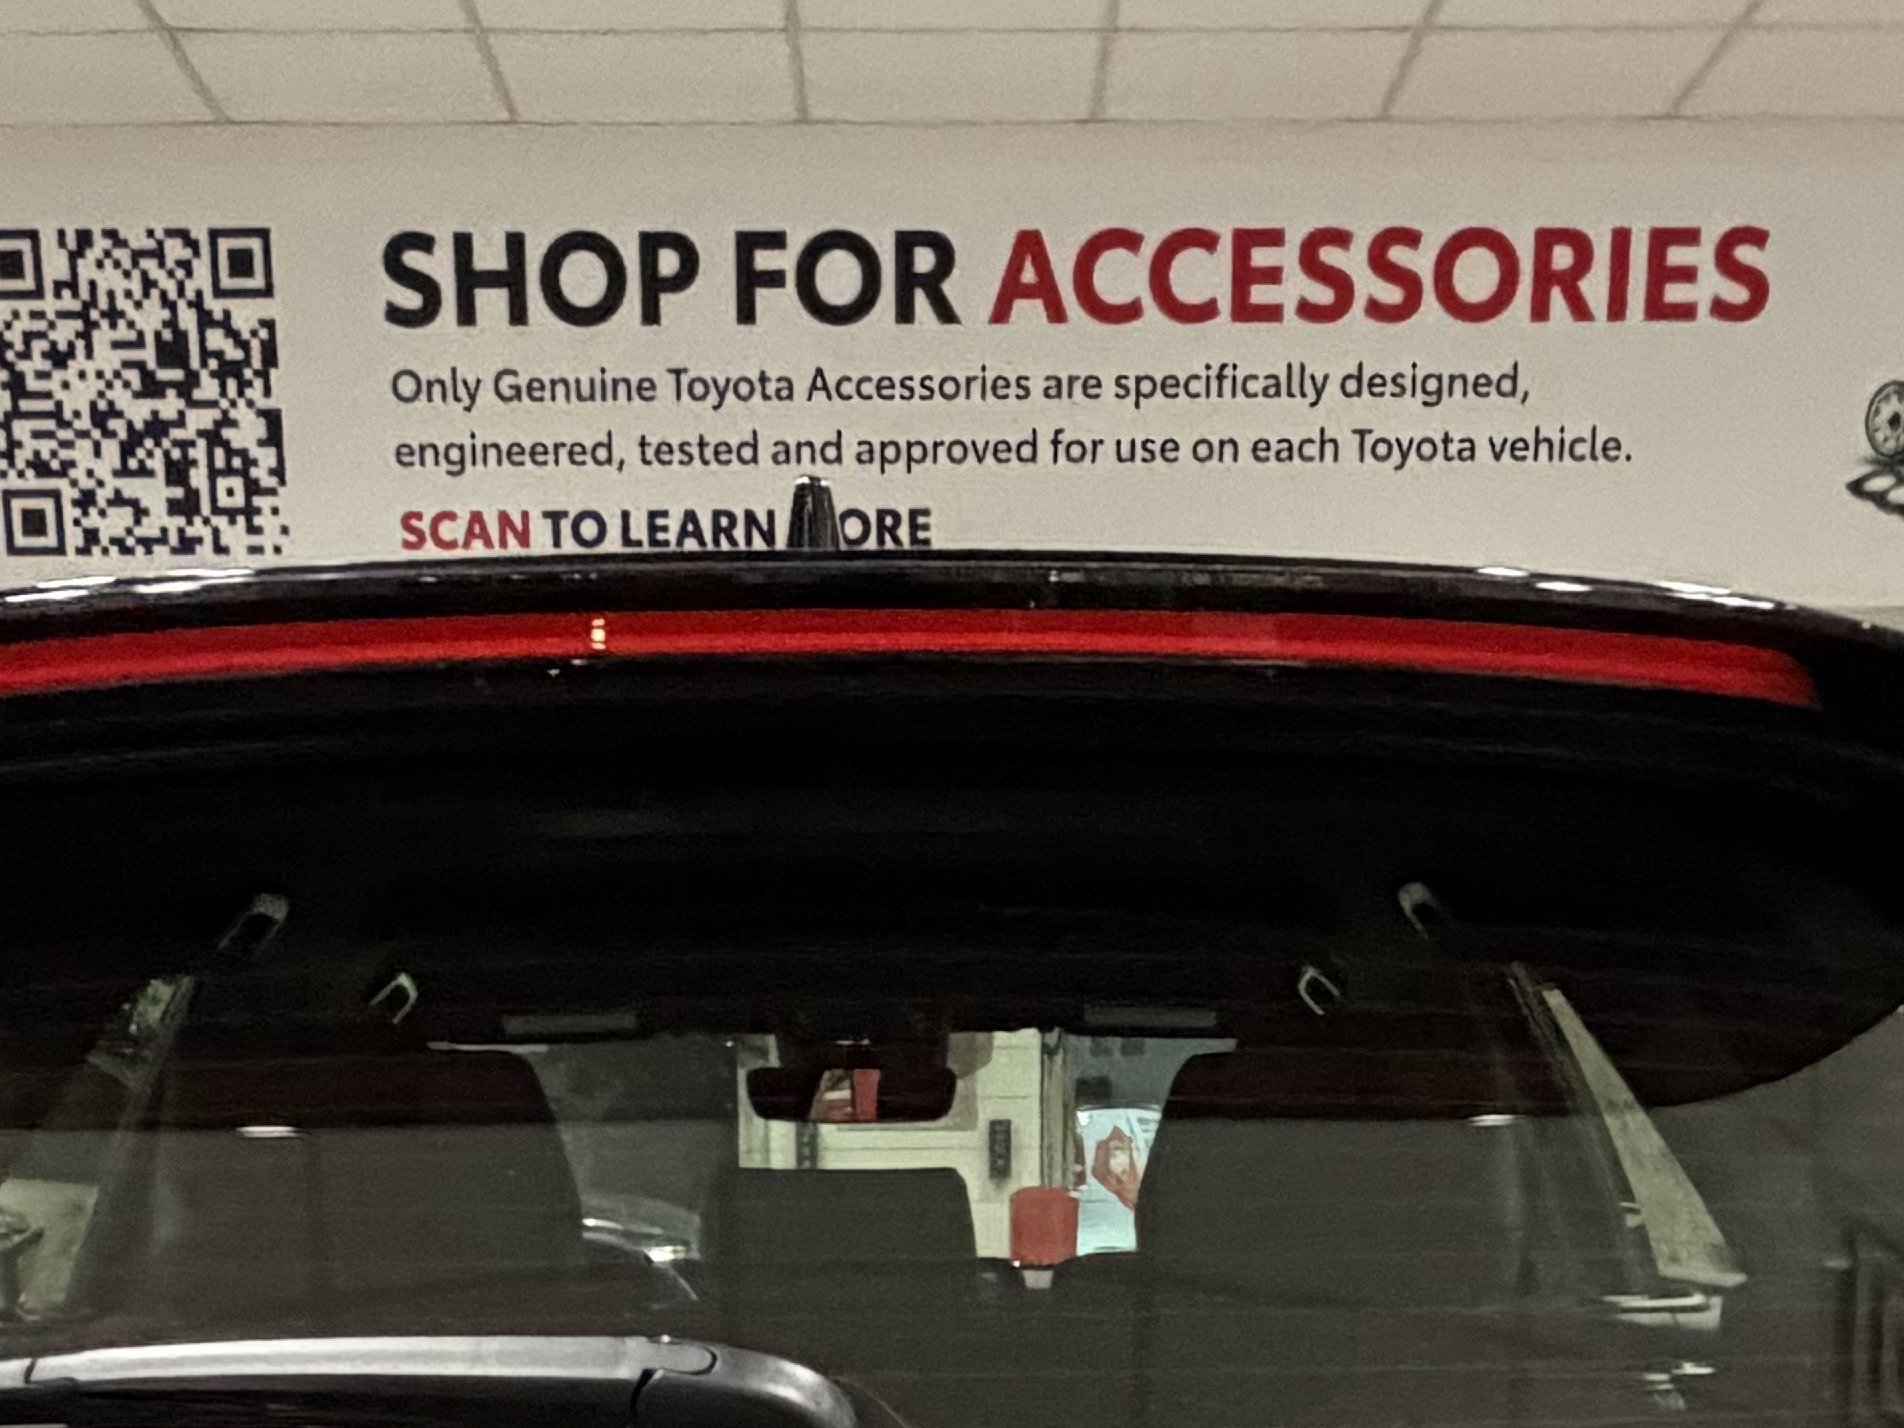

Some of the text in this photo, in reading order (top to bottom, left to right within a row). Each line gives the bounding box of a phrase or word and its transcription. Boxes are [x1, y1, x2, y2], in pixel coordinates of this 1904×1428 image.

[383, 225, 1769, 327] SHOP FOR ACCESSORIES
[392, 361, 1529, 411] Only Genuine Toyota Accessories are specifically designed,
[395, 425, 1631, 476] engineered, tested and approved for use on each Toyota vehicle.
[401, 508, 932, 549] SCAN TO LEARN ORE
